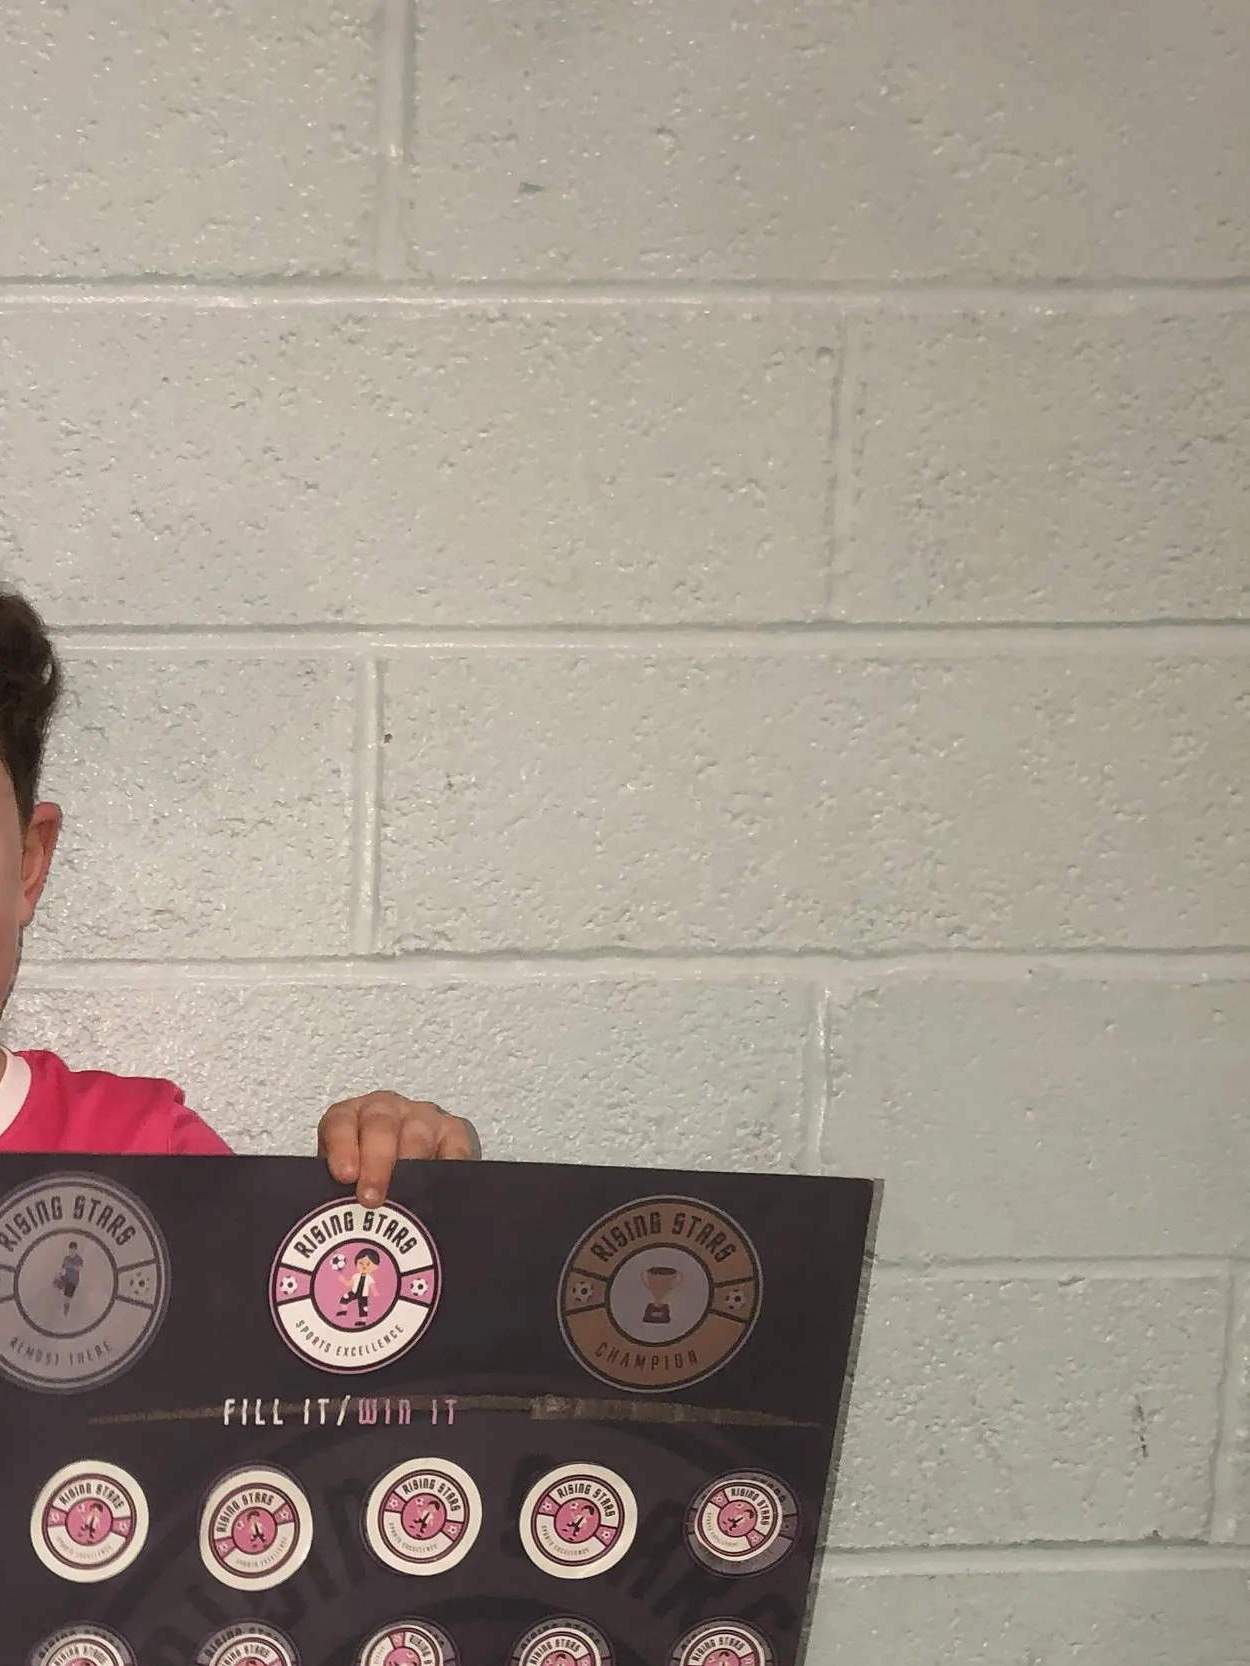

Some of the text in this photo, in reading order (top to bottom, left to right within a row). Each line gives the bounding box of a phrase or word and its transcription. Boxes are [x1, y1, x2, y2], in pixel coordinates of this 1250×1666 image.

[73, 1194, 137, 1248] STARS
[294, 1210, 418, 1259] RISING STARS
[591, 1212, 737, 1264] RISING STARS
[295, 1318, 405, 1358] SPORTS EXCELLENCE
[593, 1341, 700, 1372] CHAMPION
[222, 1397, 284, 1427] FILL
[431, 1398, 458, 1426] IT
[402, 1477, 461, 1512] RISING STARS
[556, 1482, 616, 1518] RISING STARS
